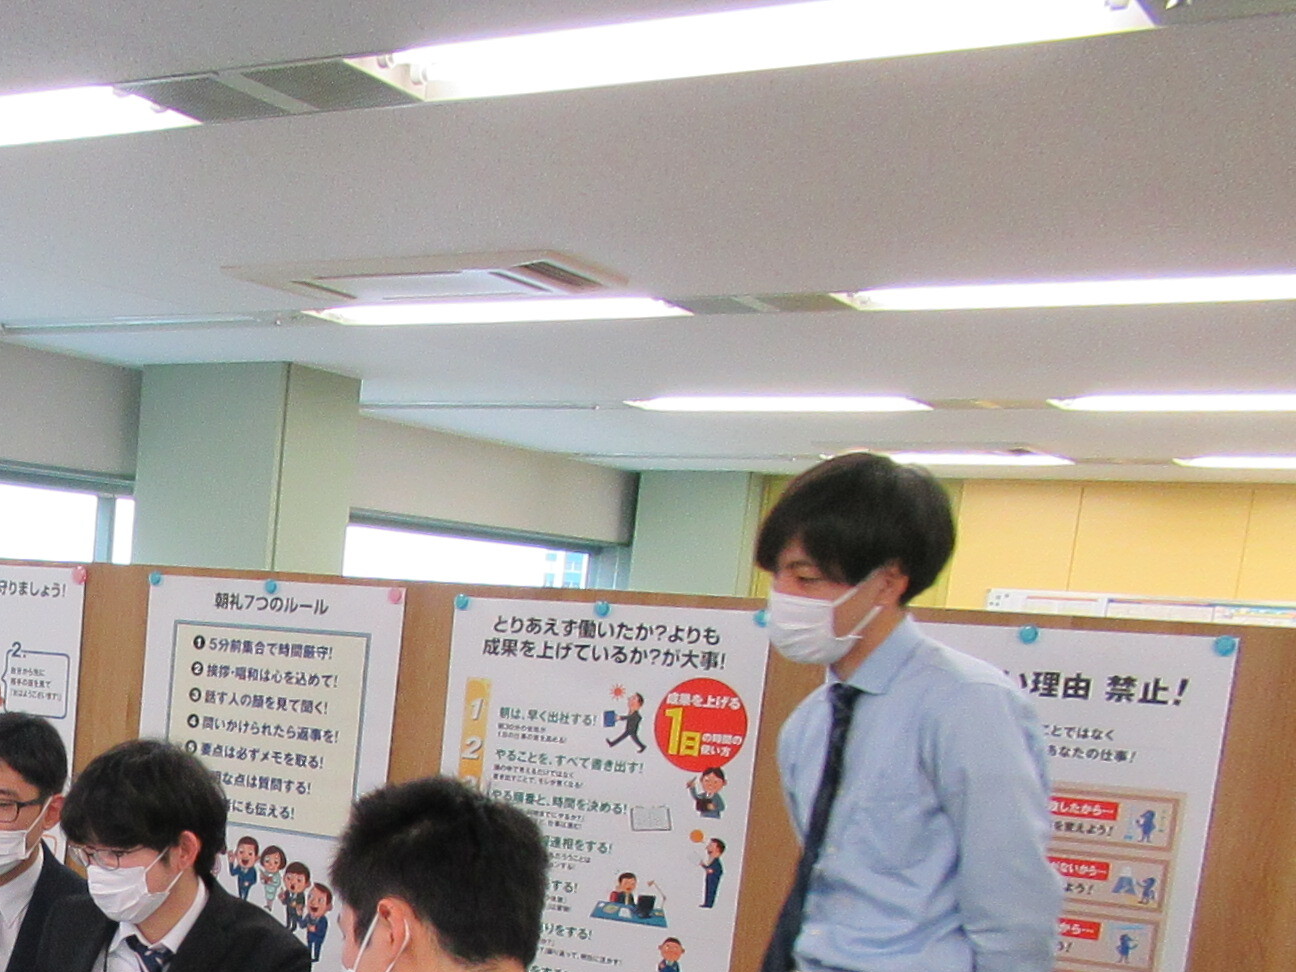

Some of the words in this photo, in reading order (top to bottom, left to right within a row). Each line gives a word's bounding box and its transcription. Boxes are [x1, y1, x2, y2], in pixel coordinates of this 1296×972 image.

[214, 592, 329, 615] 朝礼7つのルール
[209, 637, 333, 661] 5分前集合で時間厳守!
[482, 638, 726, 671] 成果を上げているか?が大事!
[204, 689, 328, 715] 話す人の顔を見て聞く!
[1105, 675, 1189, 707] 禁止!
[201, 715, 339, 744] 問いかけられたら返事を!
[498, 706, 598, 727] 朝は、早く出社する!
[200, 742, 324, 769] 要点は必ずメモを取る!
[495, 749, 644, 774] やることを、すべて書き出す!
